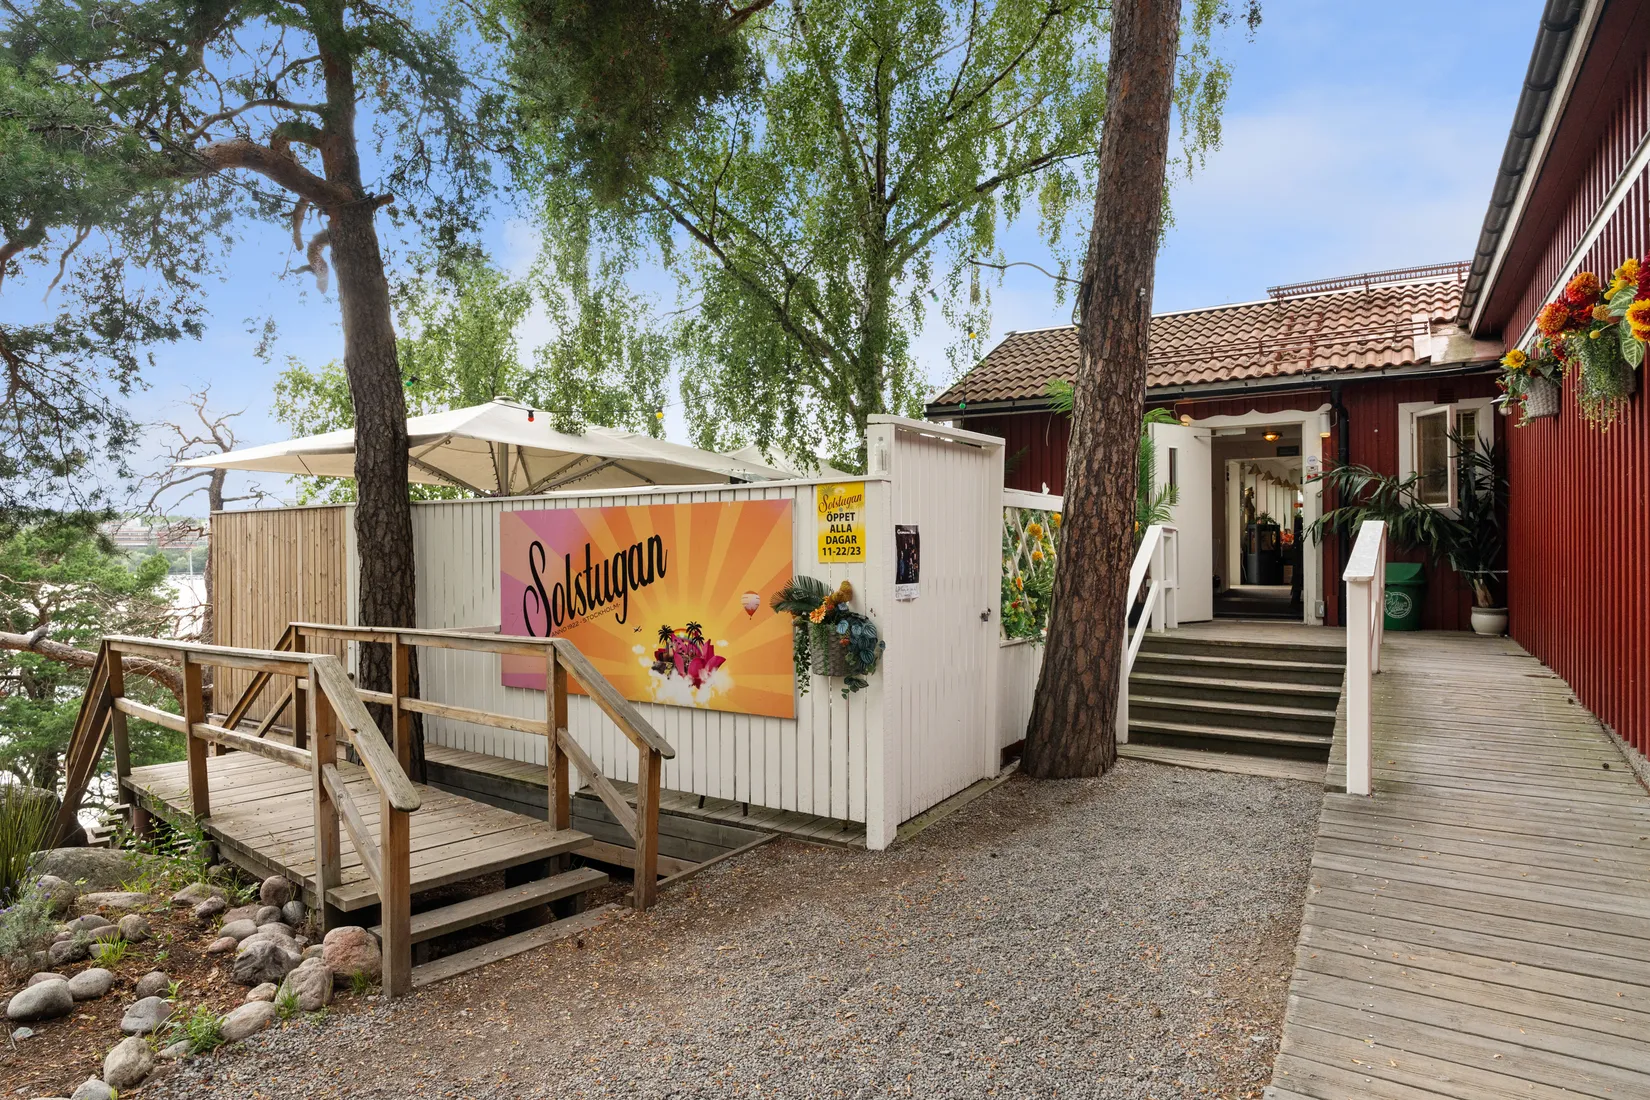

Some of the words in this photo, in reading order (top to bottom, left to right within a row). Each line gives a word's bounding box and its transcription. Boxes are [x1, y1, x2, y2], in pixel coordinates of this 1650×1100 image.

[818, 494, 863, 513] Solstugan
[826, 511, 855, 522] ÖPPET
[830, 524, 852, 533] ALLA
[826, 535, 857, 544] DAGAR
[822, 546, 861, 556] 11-22/23
[523, 534, 668, 637] Solstugan
[551, 626, 568, 637] ANNO
[567, 620, 580, 630] 1922
